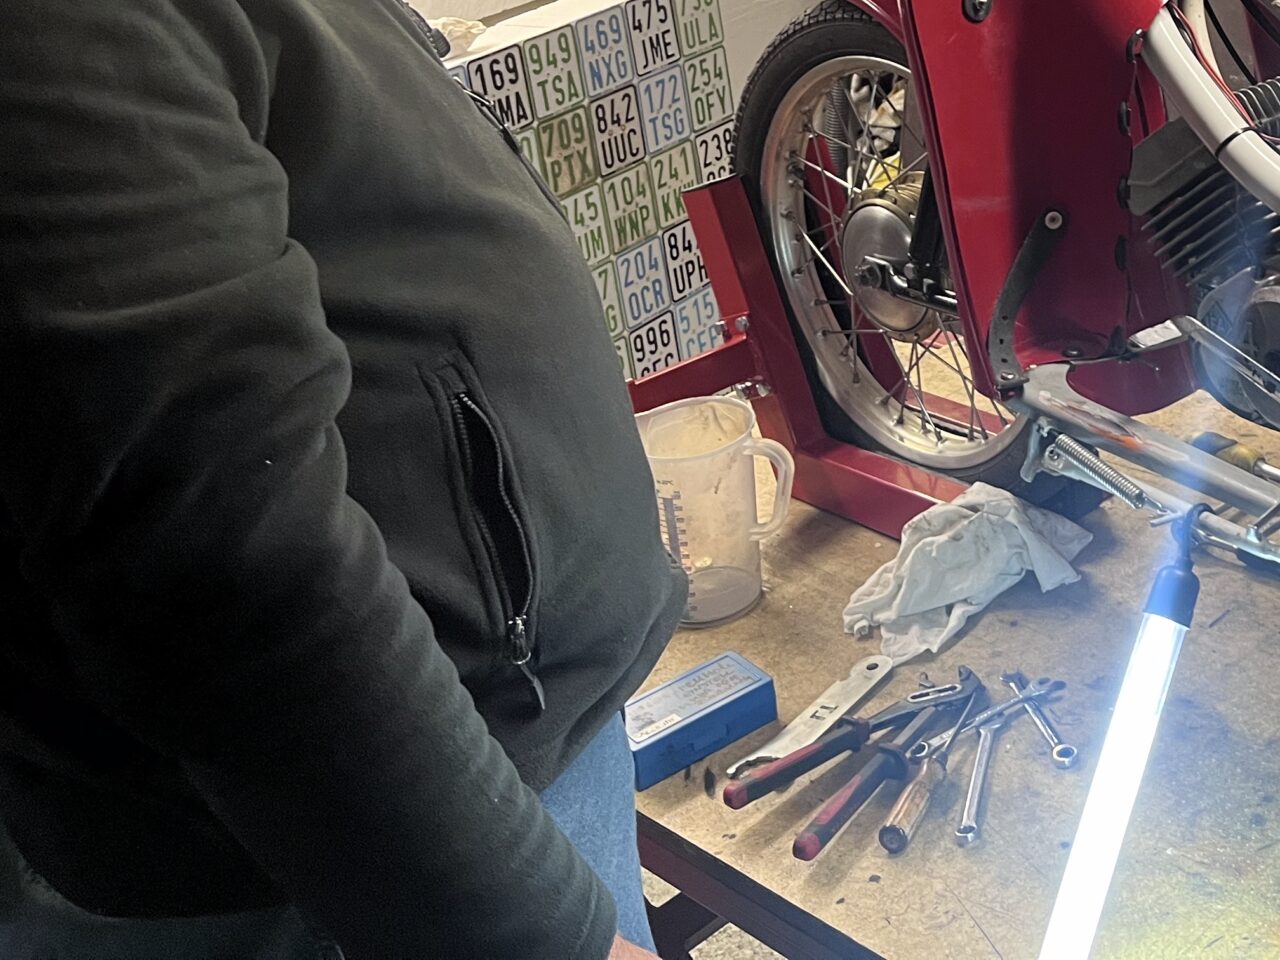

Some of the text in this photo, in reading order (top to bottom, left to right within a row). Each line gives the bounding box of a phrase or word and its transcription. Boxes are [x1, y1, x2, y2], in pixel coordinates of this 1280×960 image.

[583, 14, 622, 55] 469
[642, 29, 675, 70] JME
[683, 12, 719, 50] ULA
[475, 52, 519, 97] 169
[528, 32, 572, 76] 949
[588, 49, 628, 91] NXG
[687, 53, 723, 94] 254
[492, 91, 529, 127] MA
[536, 70, 579, 112] TSA
[643, 74, 681, 113] 172
[595, 92, 635, 134] 842
[648, 107, 686, 146] TSG
[541, 113, 585, 158] 709
[601, 128, 640, 169] UUC
[550, 146, 593, 194] PTX
[654, 146, 691, 190] 241
[560, 190, 599, 228] 45
[606, 170, 647, 212] 104
[661, 178, 695, 223] KK
[614, 204, 651, 248] WNP
[667, 226, 693, 262] 84
[620, 244, 659, 289] 204
[673, 254, 709, 295] UPH
[678, 291, 715, 335] 515
[633, 319, 671, 363] 996
